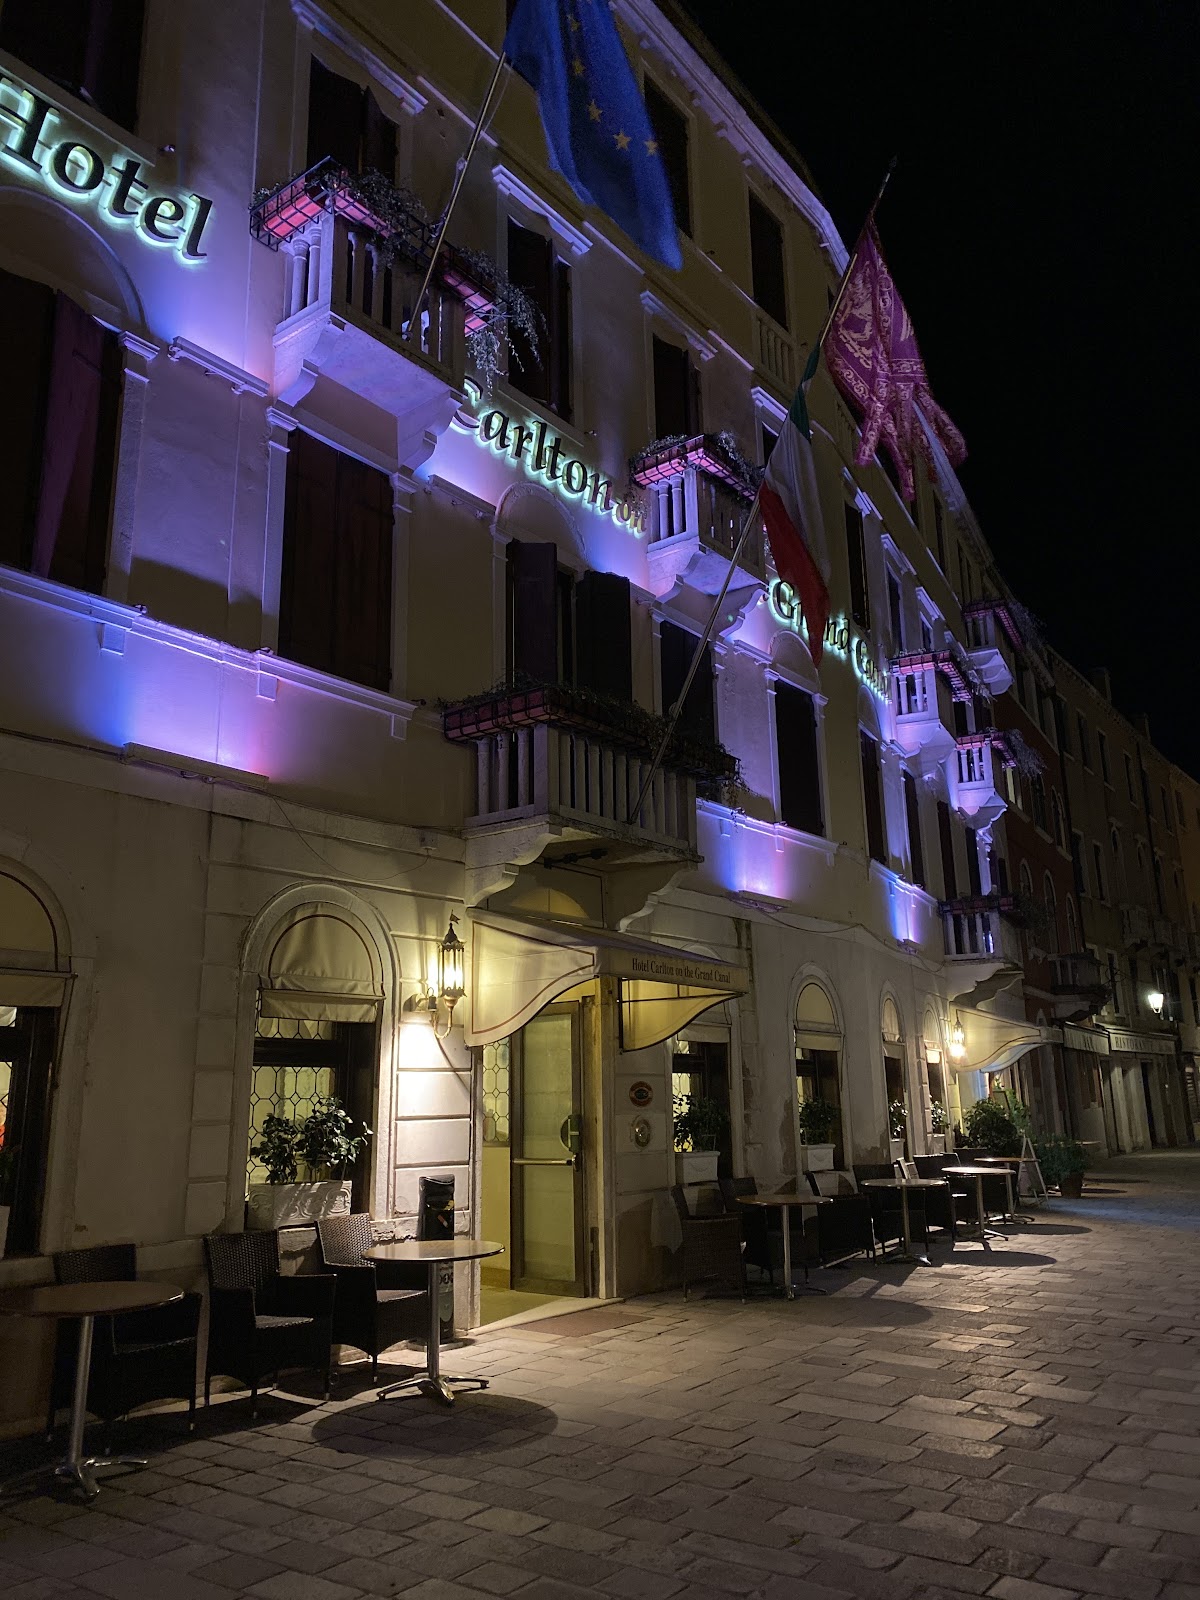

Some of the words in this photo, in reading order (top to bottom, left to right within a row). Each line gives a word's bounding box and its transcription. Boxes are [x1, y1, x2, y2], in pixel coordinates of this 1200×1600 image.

[774, 580, 851, 654] Grnd
[632, 957, 650, 973] Hotel
[651, 960, 674, 977] Carlton
[675, 967, 683, 977] on
[684, 965, 694, 979] the
[694, 967, 714, 982] Grand
[714, 971, 731, 984] Canal
